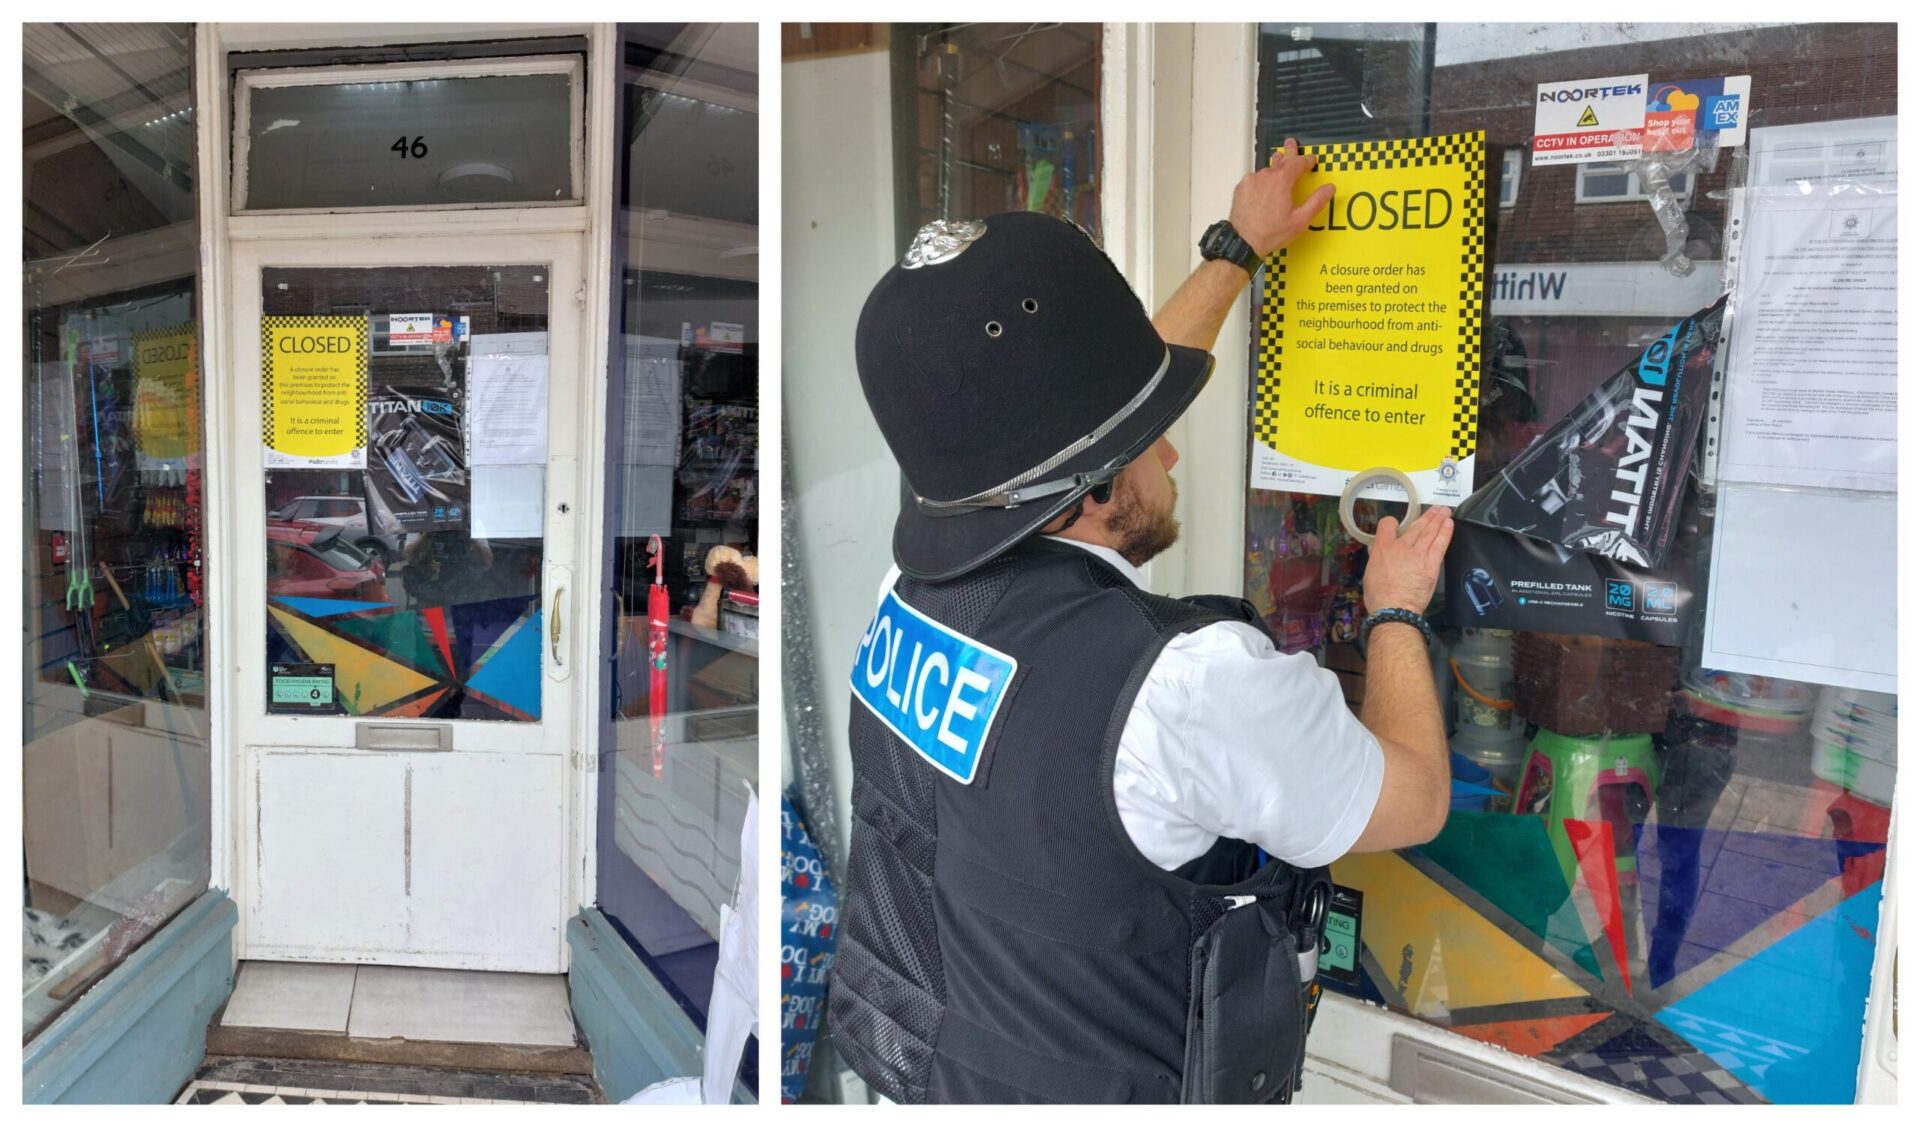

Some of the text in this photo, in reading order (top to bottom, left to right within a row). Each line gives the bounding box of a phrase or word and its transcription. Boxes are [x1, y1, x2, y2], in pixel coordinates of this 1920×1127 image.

[1540, 83, 1642, 103] NOORTEK
[1647, 118, 1669, 129] Shop
[390, 135, 428, 159] 46
[1536, 136, 1564, 148] CCTV
[1566, 135, 1578, 147] IN
[1534, 151, 1591, 162] www.noortek.co.uk
[1597, 150, 1616, 159] 03301
[1320, 263, 1425, 276] A closure order has
[1325, 281, 1418, 296] been granted on
[1296, 298, 1447, 315] this premises to protect the
[1299, 317, 1443, 332] neighbourhood from anti-
[279, 336, 351, 354] CLOSED
[1296, 338, 1444, 357] social behaviour and drugs
[1314, 379, 1418, 400] It is a criminal
[369, 400, 449, 414] TITAN 10K
[290, 417, 296, 425] It
[297, 417, 304, 425] is
[310, 417, 340, 425] criminal
[1304, 403, 1426, 426] offence to enter
[286, 427, 314, 436] offence
[1511, 580, 1593, 592] PREFILLED TANK
[1608, 583, 1632, 596] 20
[1608, 595, 1672, 609] MG ML
[1605, 610, 1678, 623] NICOTINE CAPSULES
[855, 614, 992, 755] POLICE
[312, 690, 319, 699] 4
[1327, 916, 1350, 931] TING
